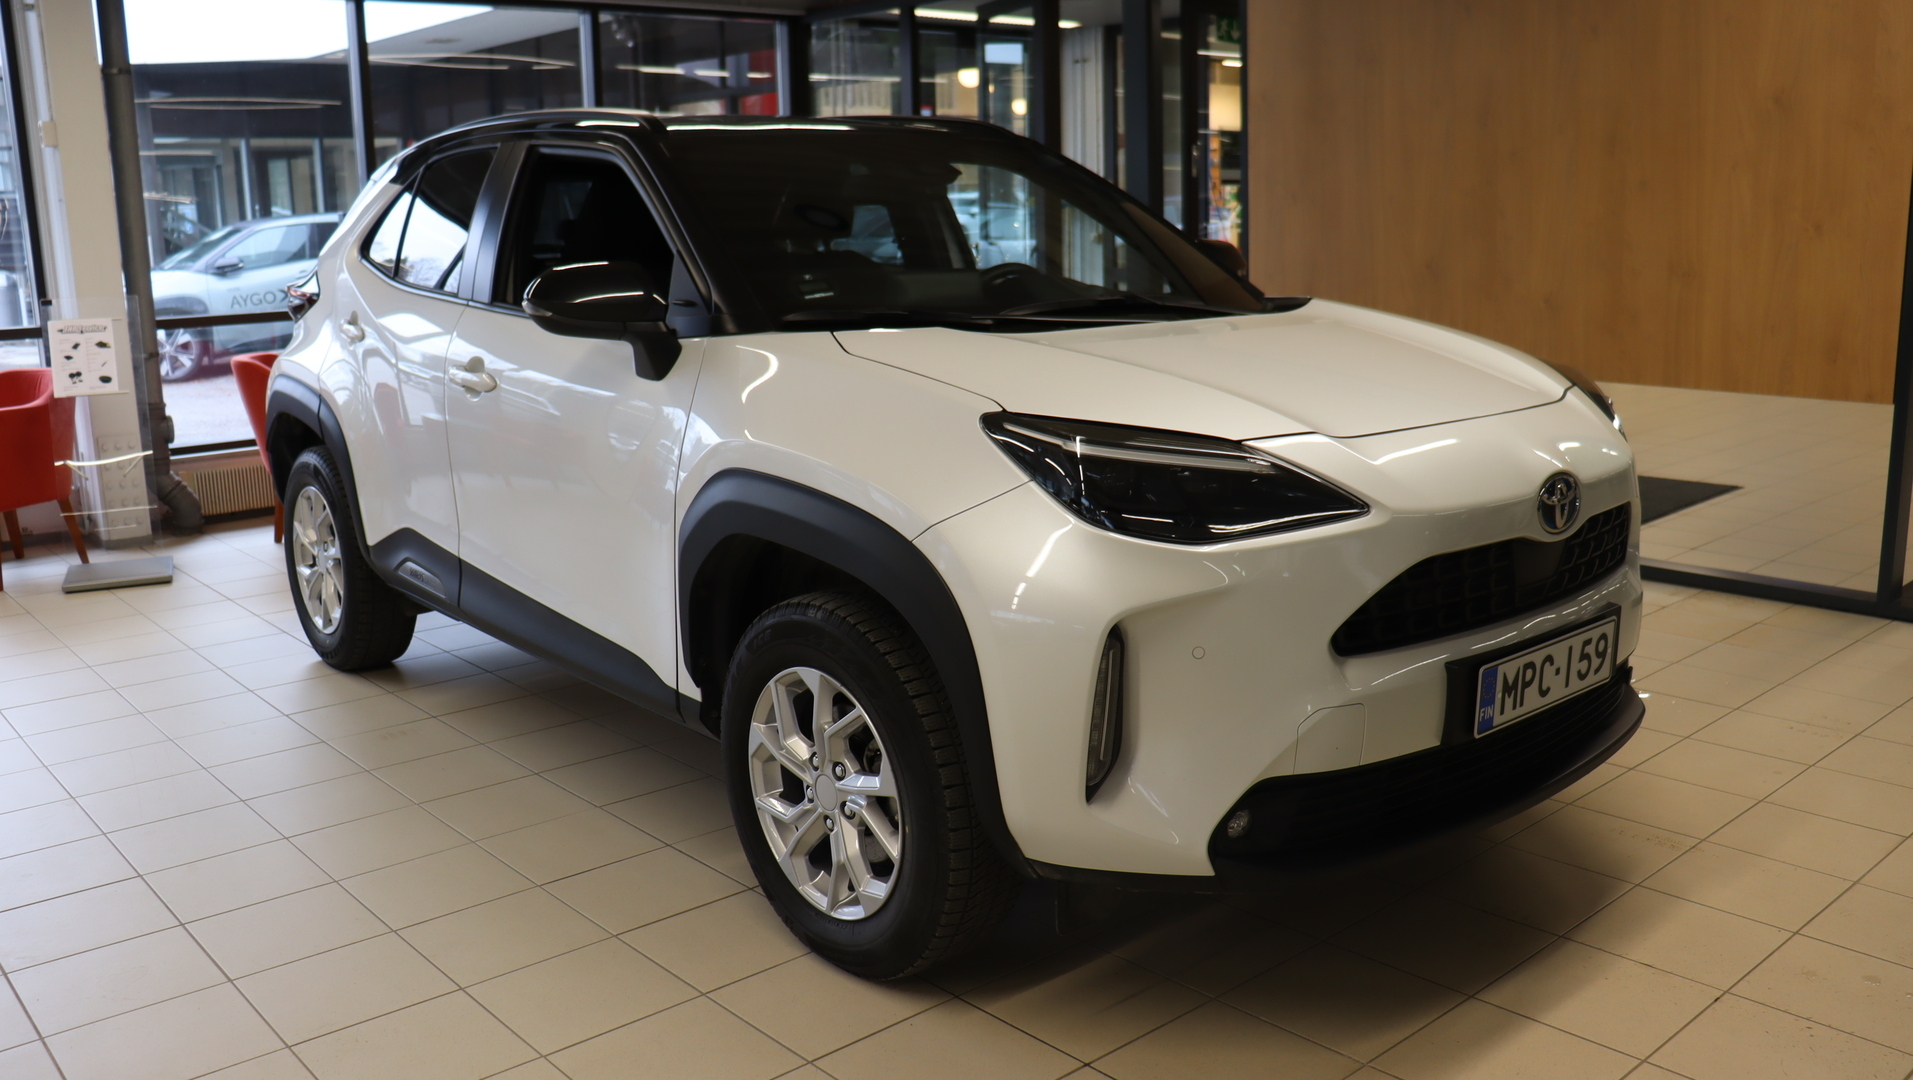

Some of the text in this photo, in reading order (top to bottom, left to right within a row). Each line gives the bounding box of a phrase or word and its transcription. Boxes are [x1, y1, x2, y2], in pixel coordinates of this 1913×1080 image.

[231, 290, 277, 309] AYGO
[1499, 632, 1609, 716] MPC-159
[1479, 704, 1494, 722] FIN
